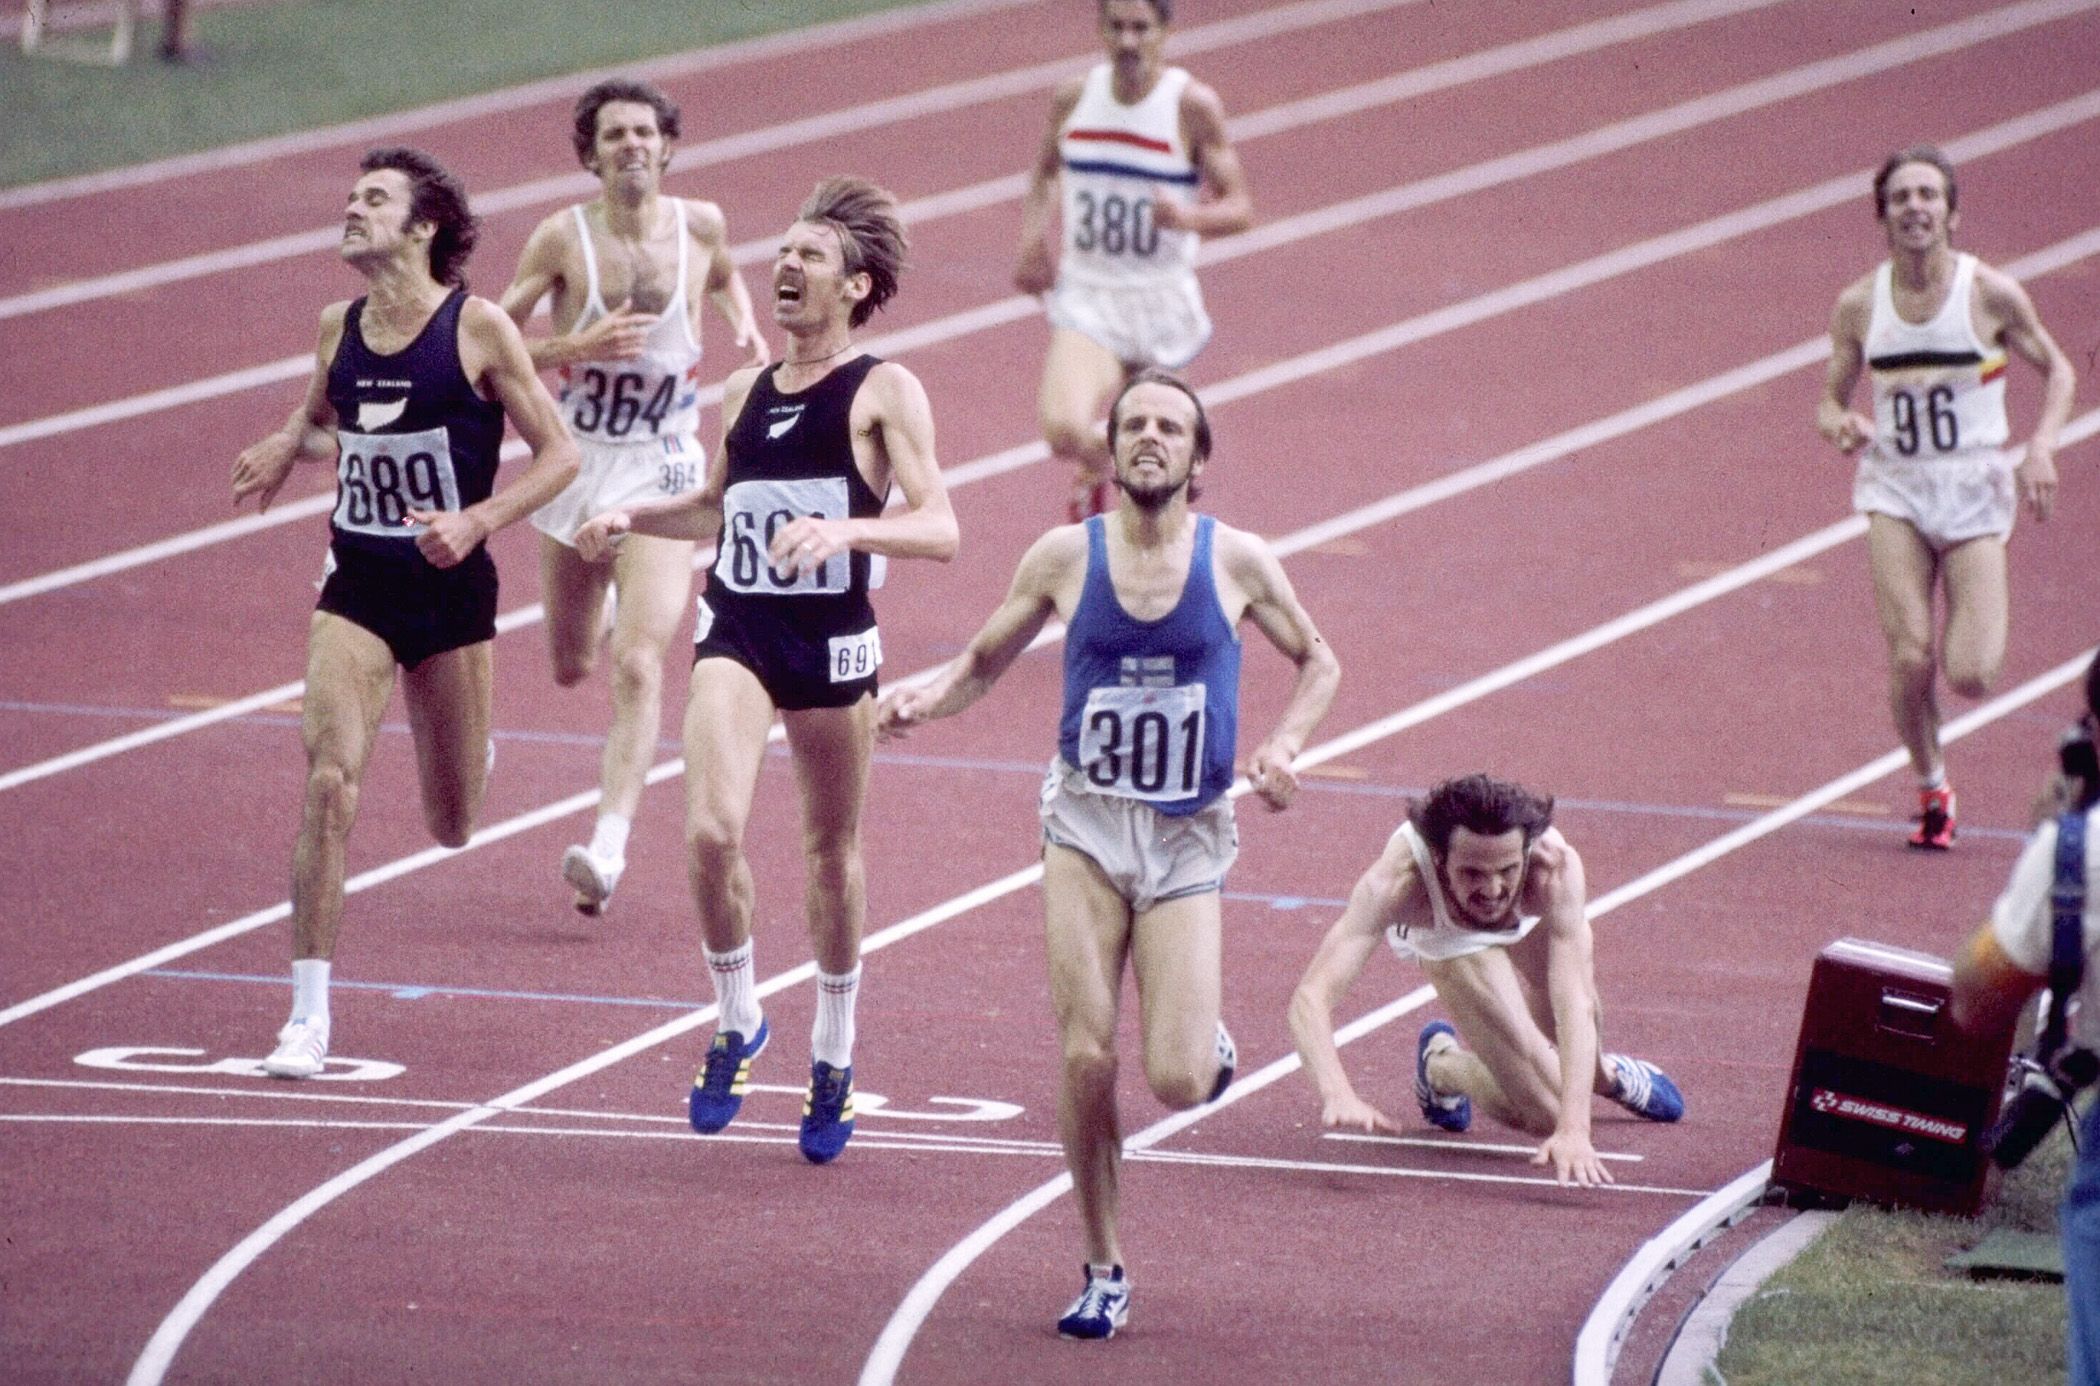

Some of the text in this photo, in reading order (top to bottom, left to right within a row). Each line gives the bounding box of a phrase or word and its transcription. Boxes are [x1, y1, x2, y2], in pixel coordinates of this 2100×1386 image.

[1074, 190, 1159, 258] 380
[356, 379, 412, 389] NEW ZEALAND
[574, 367, 679, 437] 364
[1893, 384, 1959, 457] 96
[345, 451, 447, 528] 689
[1088, 709, 1200, 793] 301
[1838, 1100, 1966, 1140] SWISS TIMING
